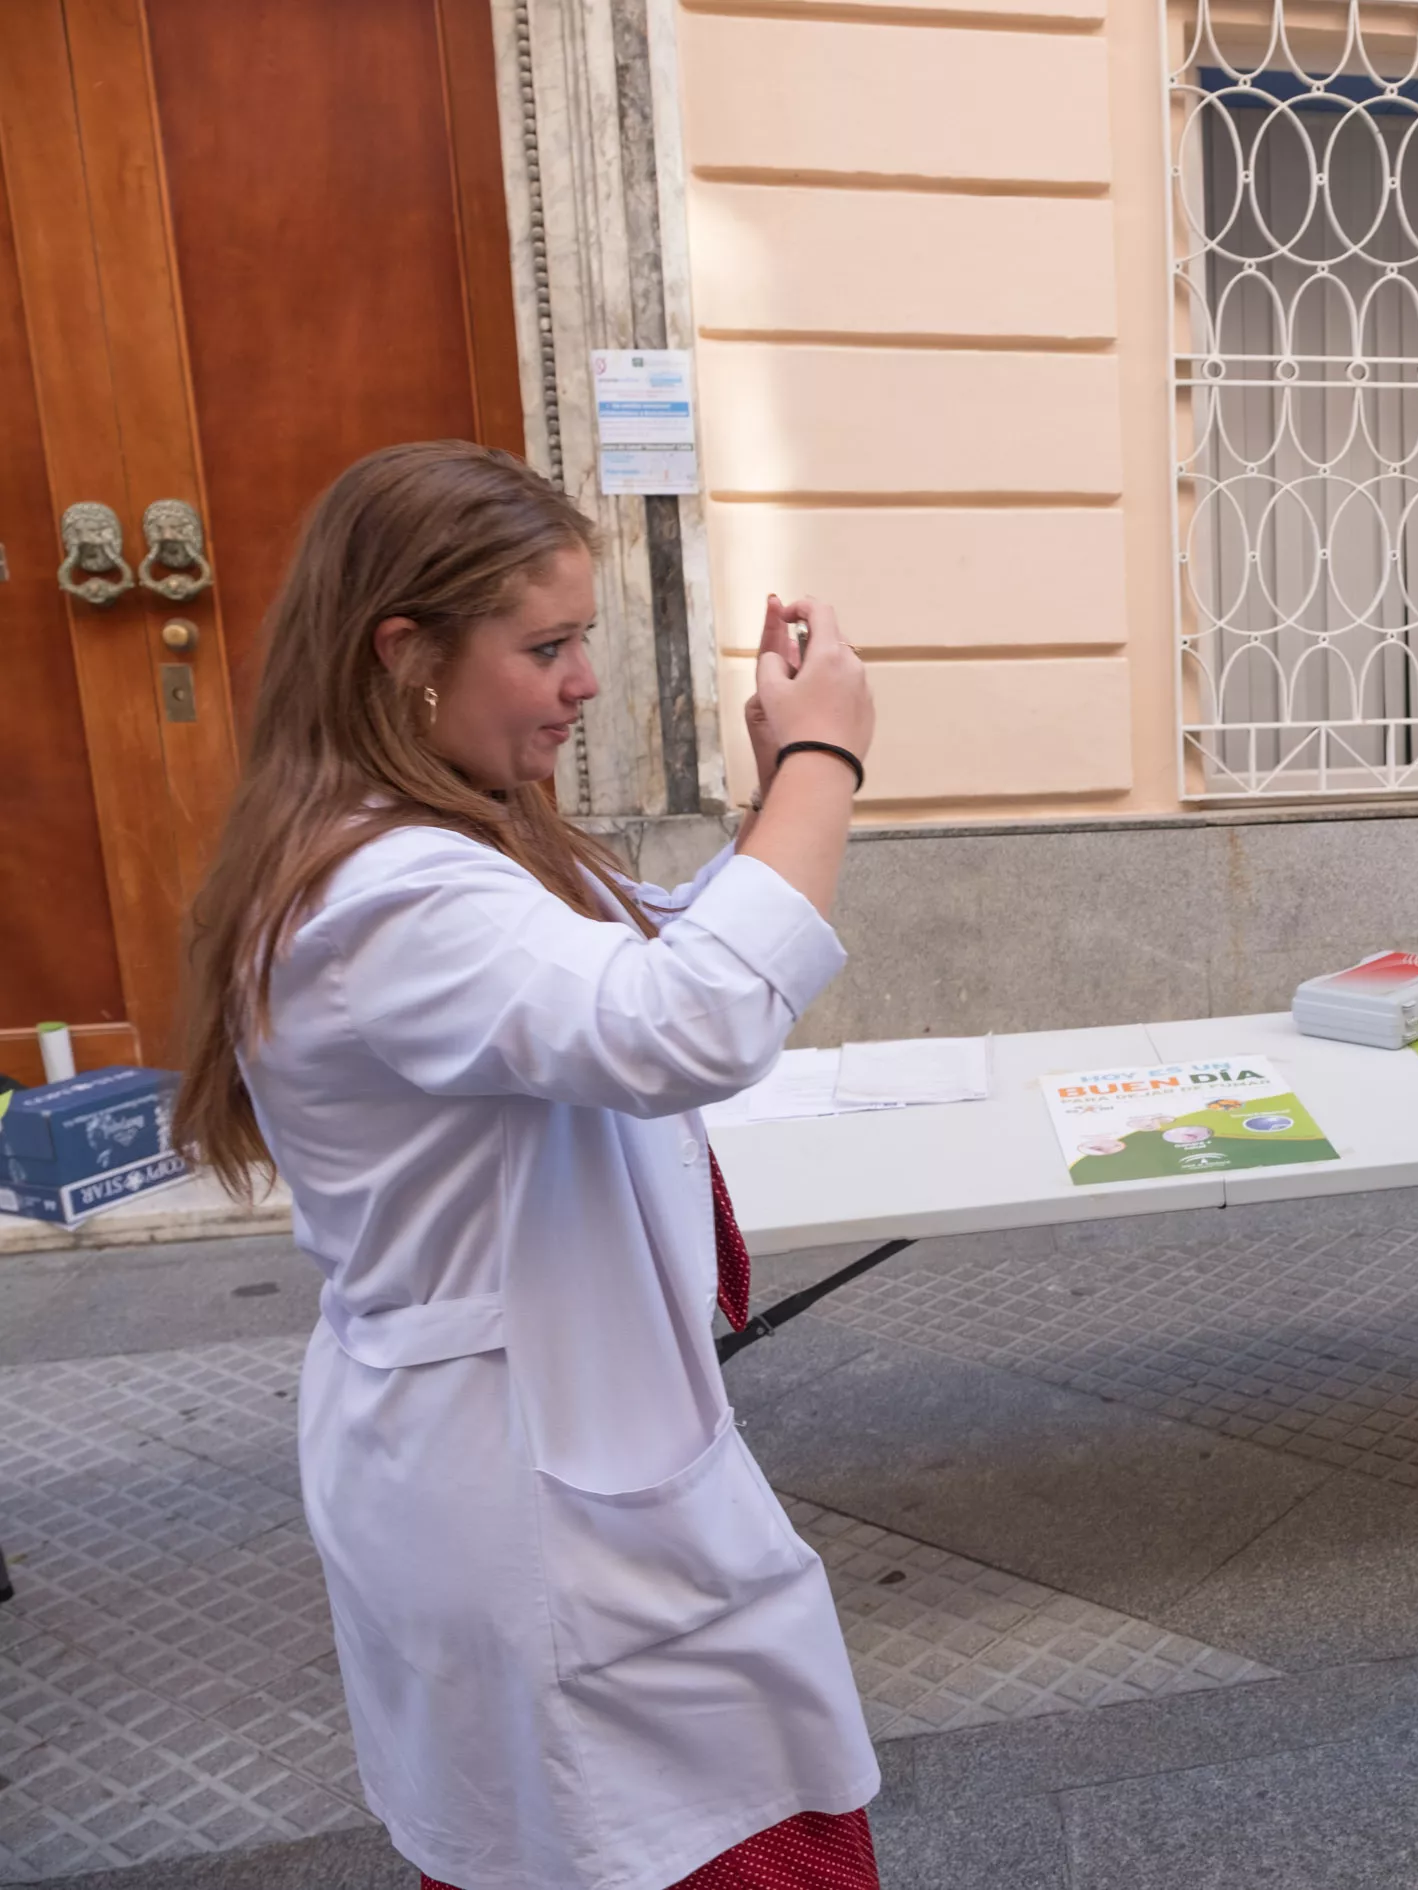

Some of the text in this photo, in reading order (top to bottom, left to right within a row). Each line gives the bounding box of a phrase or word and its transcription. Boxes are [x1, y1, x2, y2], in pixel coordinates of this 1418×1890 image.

[1057, 1067, 1266, 1098] BUEN DÍA
[1080, 1062, 1232, 1084] HOY ES UN
[1061, 1078, 1272, 1104] PARA DEJAR DE FUMAR
[81, 1156, 185, 1204] COPY STAR
